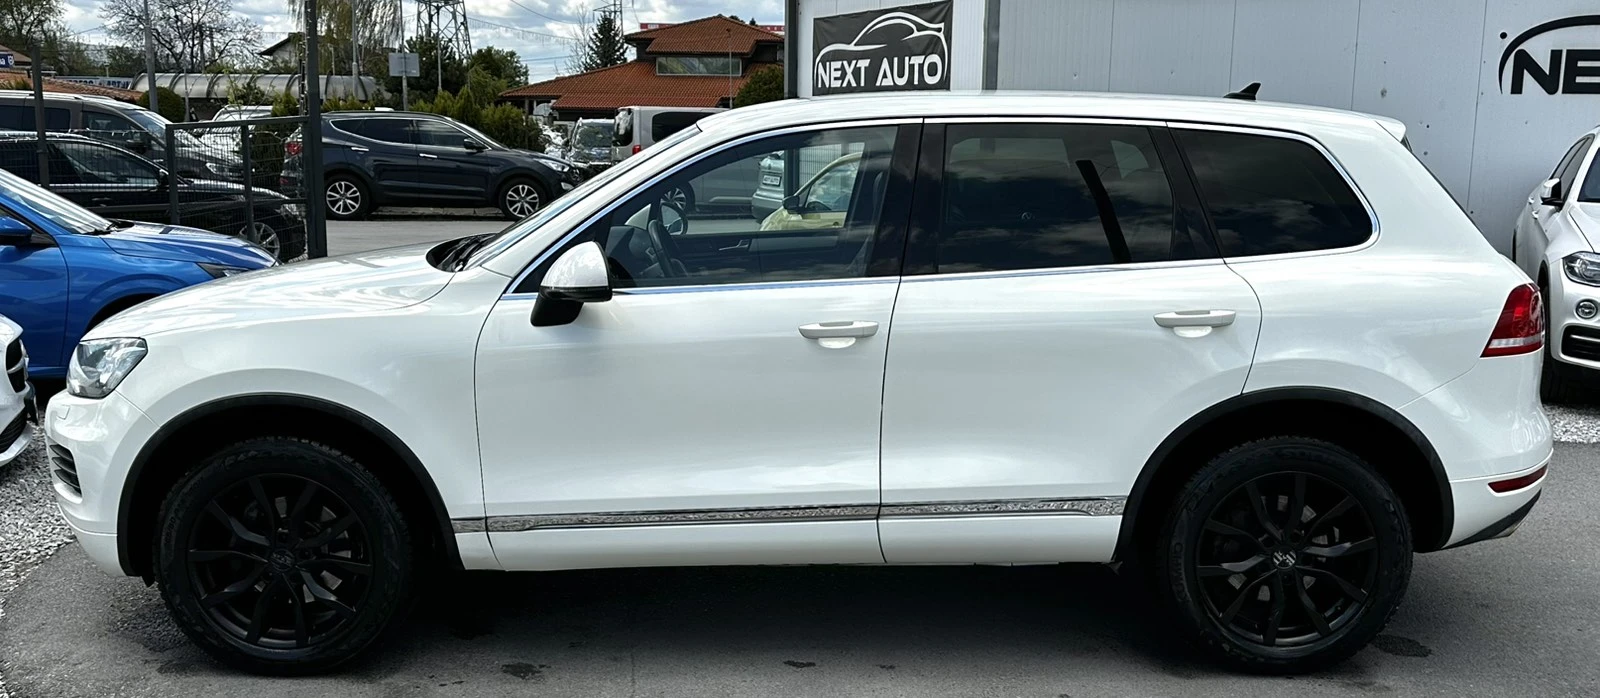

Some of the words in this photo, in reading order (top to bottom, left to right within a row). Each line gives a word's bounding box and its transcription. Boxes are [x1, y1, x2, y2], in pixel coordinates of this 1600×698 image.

[818, 59, 870, 88] NEXT
[876, 54, 942, 86] AUTO
[1510, 49, 1600, 95] NE
